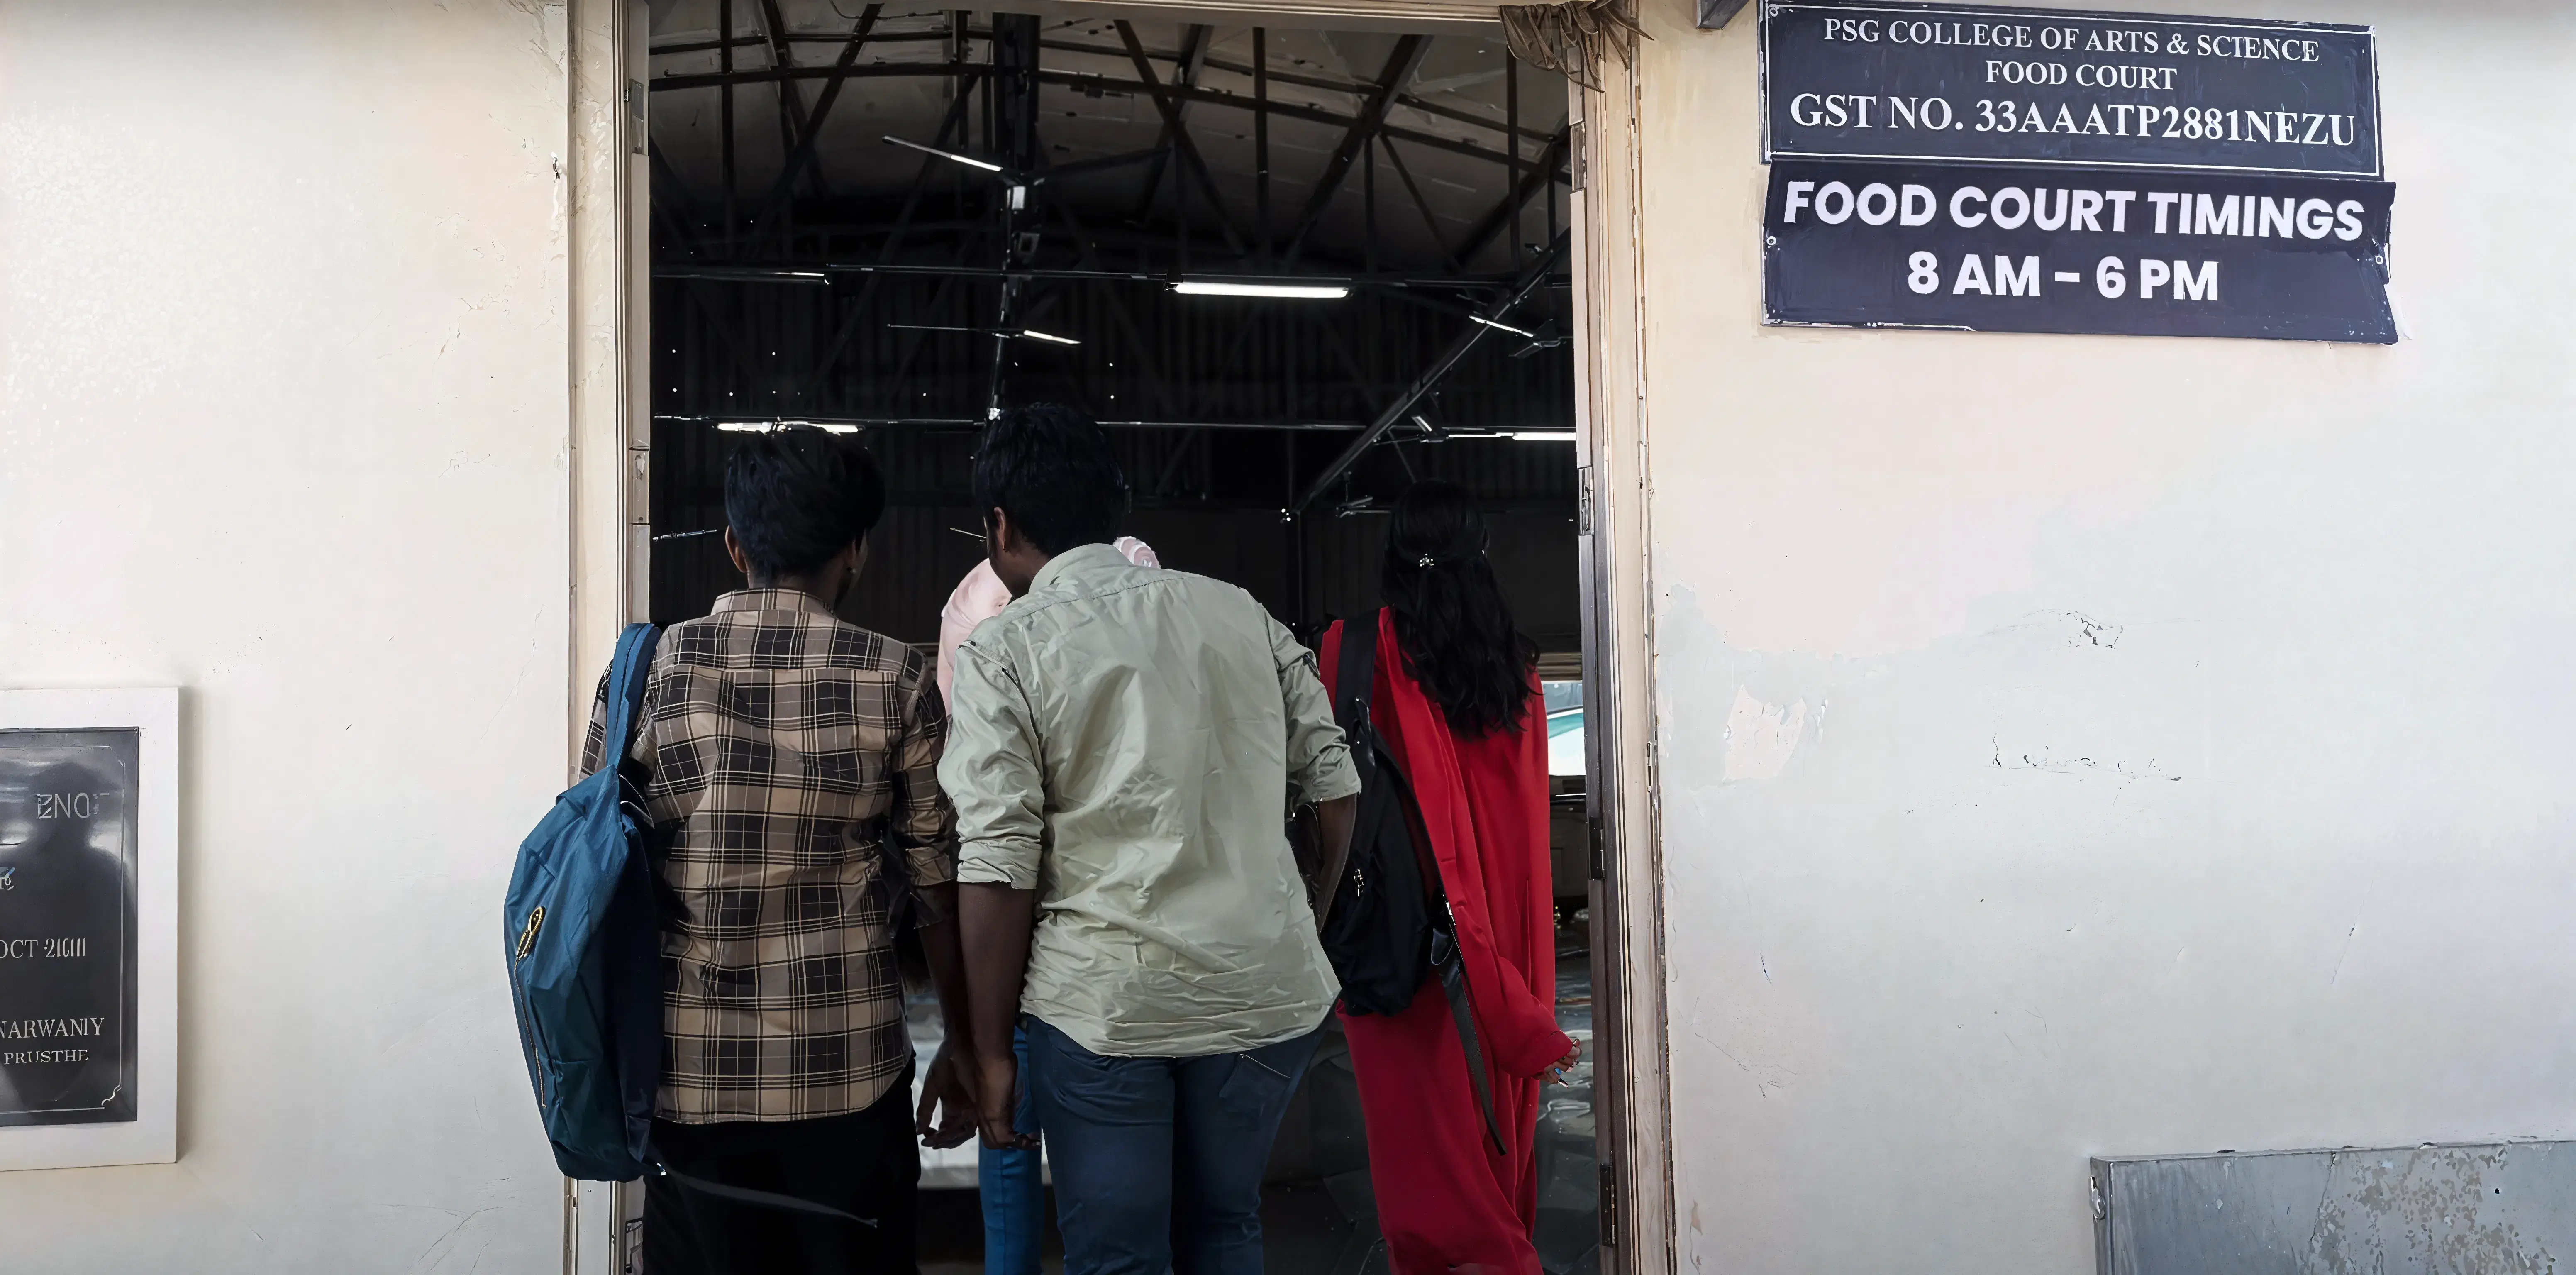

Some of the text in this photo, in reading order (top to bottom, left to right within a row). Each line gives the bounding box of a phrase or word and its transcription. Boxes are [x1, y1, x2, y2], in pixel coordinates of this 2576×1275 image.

[1824, 18, 2320, 62] PSG COLLEGE OF ARTS & SCIENCE
[1985, 60, 2177, 90] FOOD COURT
[1791, 93, 2355, 146] GST NO. 33AAATP2881NEZU
[1784, 181, 2365, 241] FOOD COURT TIMINGS
[1908, 251, 1939, 294] 8
[1952, 254, 2041, 296] AM
[2096, 256, 2126, 299] 6
[2140, 259, 2219, 301] PM
